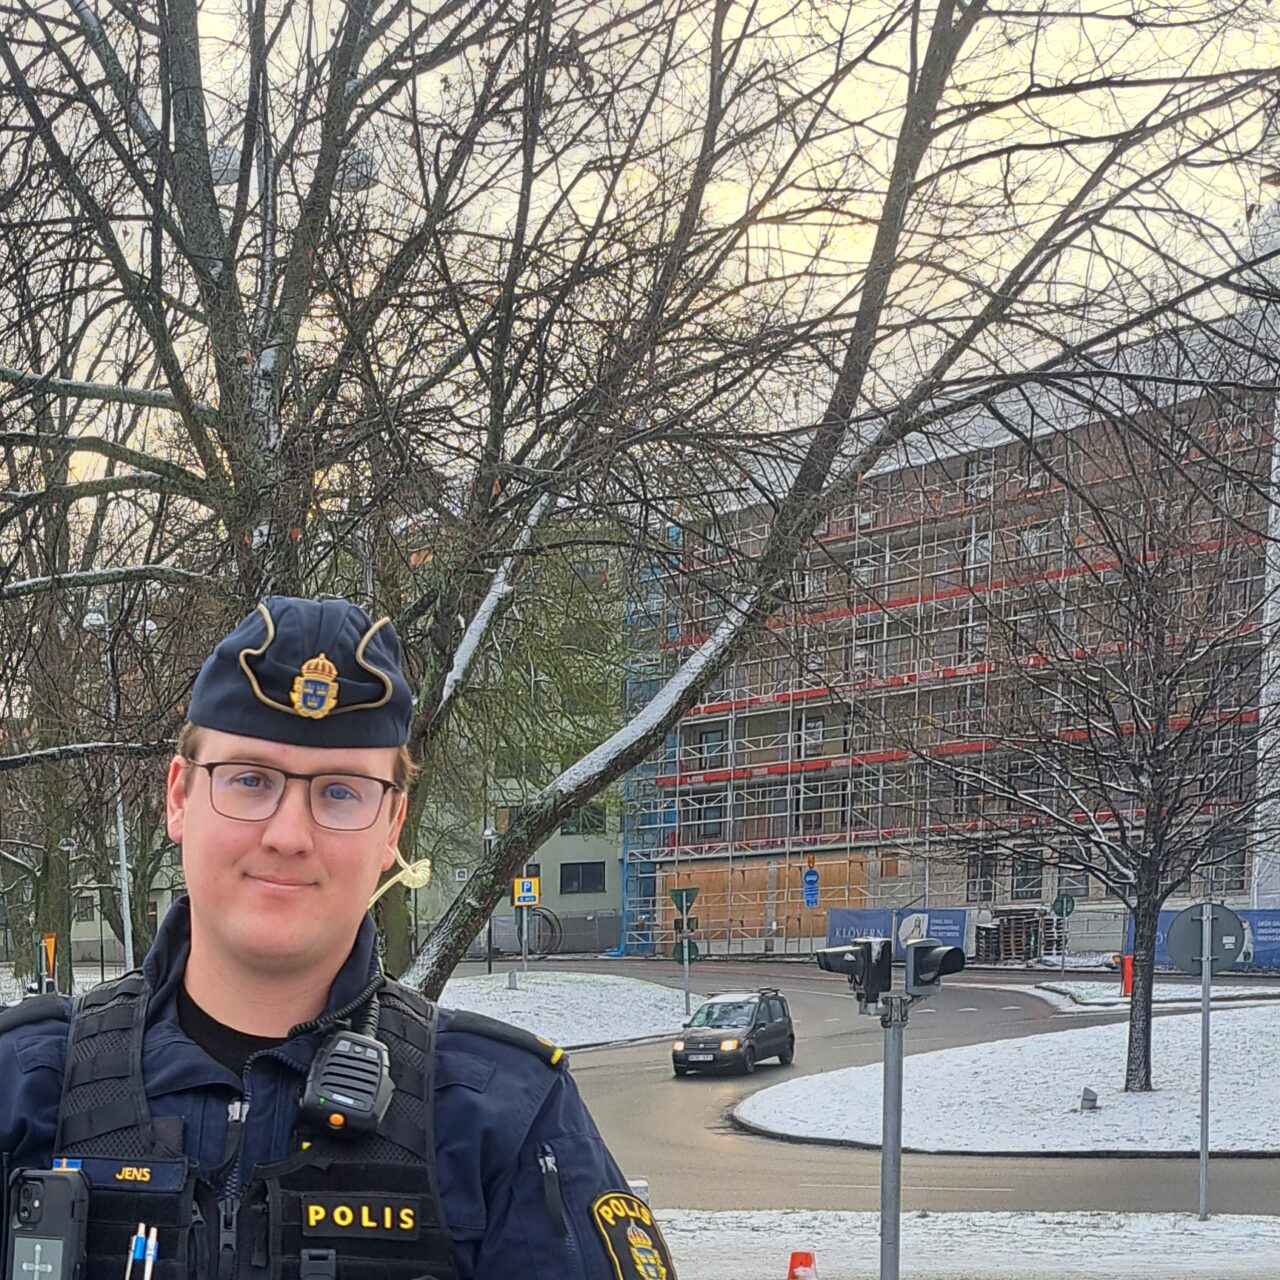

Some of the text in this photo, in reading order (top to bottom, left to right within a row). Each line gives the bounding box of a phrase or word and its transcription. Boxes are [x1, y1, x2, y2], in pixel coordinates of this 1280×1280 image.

[115, 1166, 151, 1182] JENS
[308, 1205, 415, 1229] POLIS
[599, 1199, 651, 1226] POLIS
